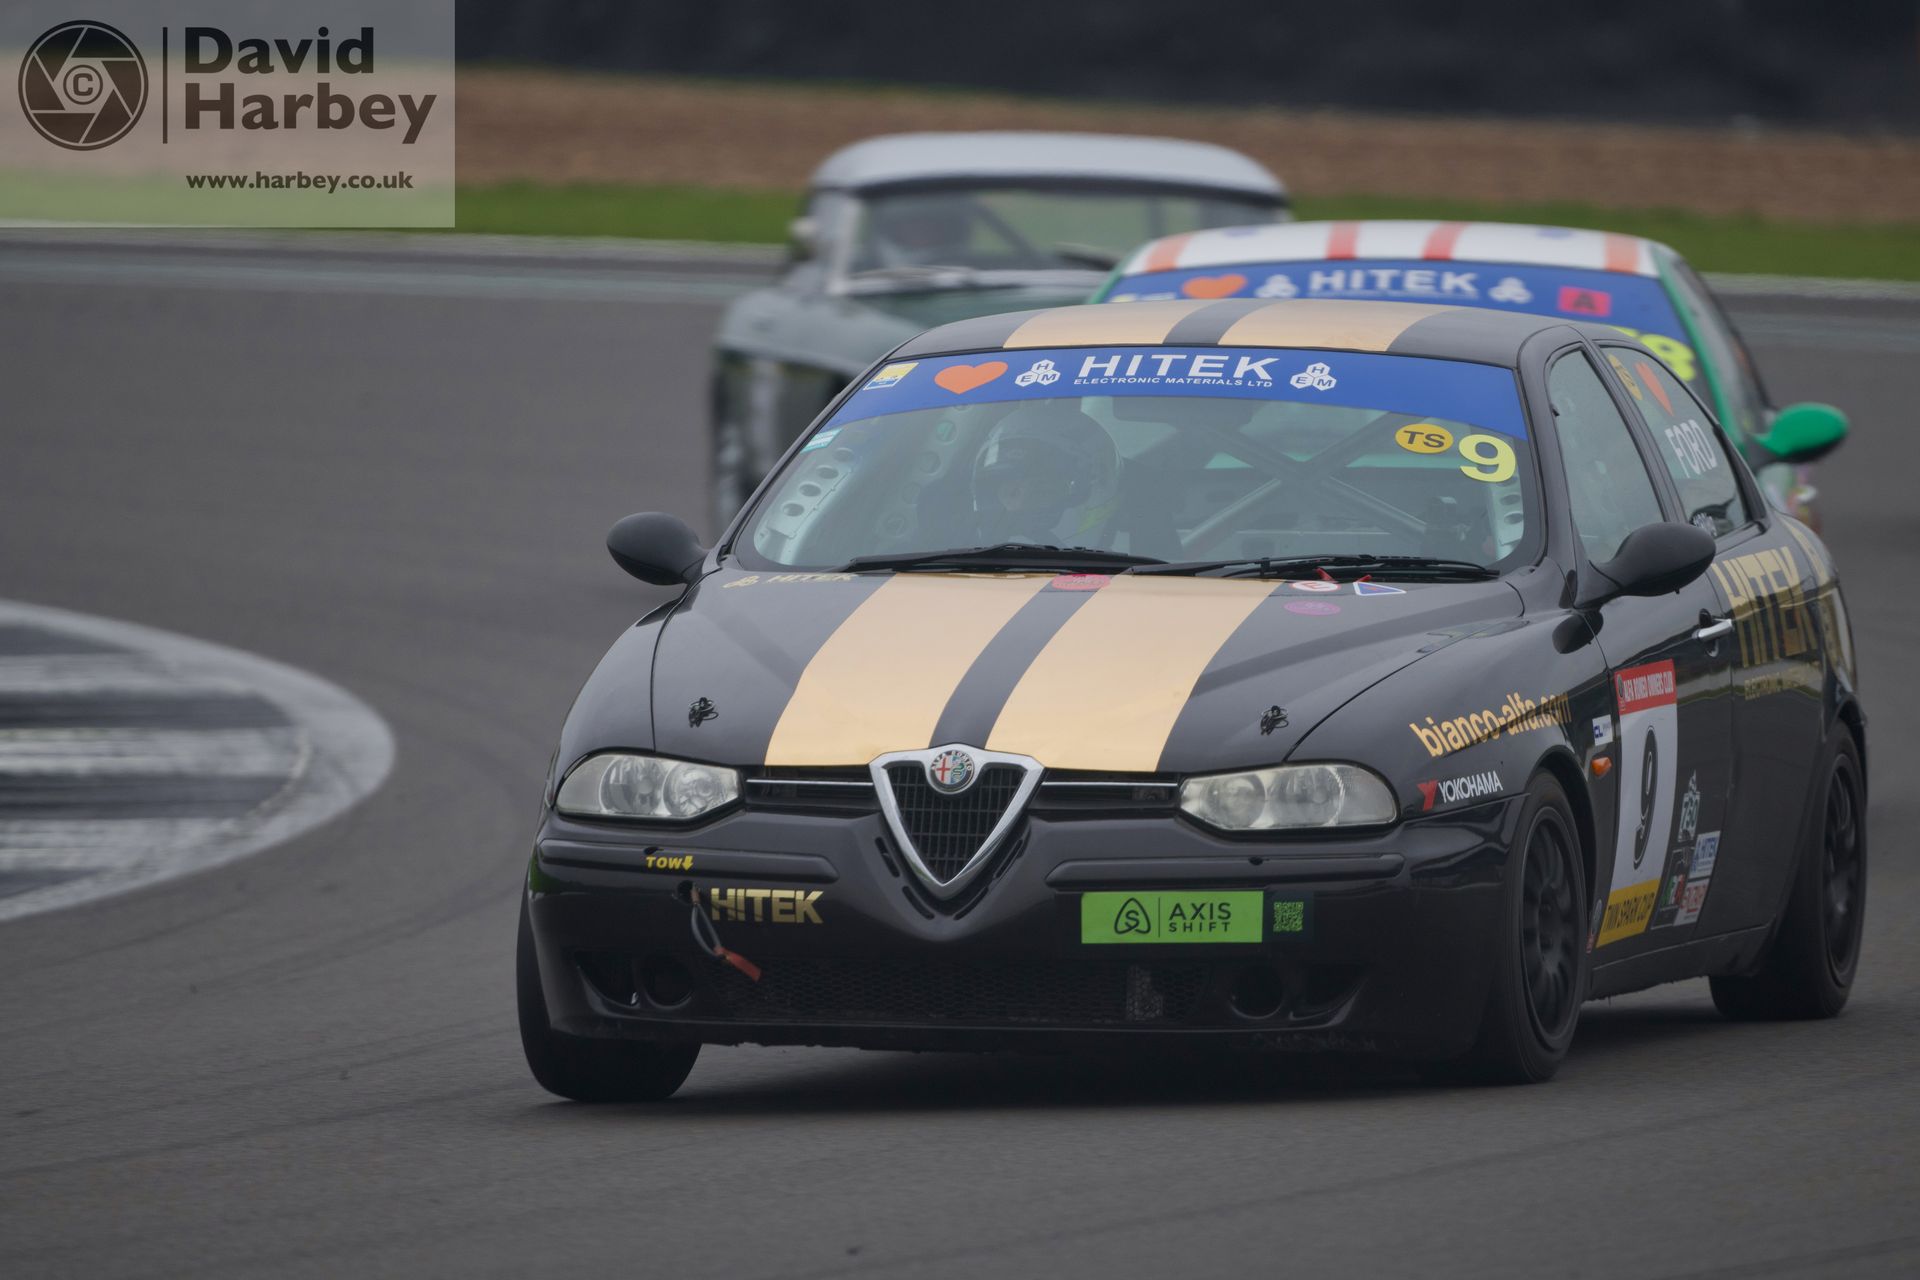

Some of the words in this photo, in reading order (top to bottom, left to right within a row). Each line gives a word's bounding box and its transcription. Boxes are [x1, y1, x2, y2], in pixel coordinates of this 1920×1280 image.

[1308, 269, 1479, 293] HITEK
[1077, 354, 1280, 380] HITEK
[1074, 377, 1160, 386] ELECTRONIC
[1165, 377, 1242, 386] MATERIALS
[1247, 380, 1273, 388] LTD
[1403, 430, 1446, 448] TS
[1664, 419, 1717, 478] FORD
[1458, 434, 1516, 482] 9
[1710, 546, 1818, 668] HITEK
[1409, 692, 1572, 757] bianco-alfa.com
[1438, 770, 1504, 803] YOKOHAMA
[1633, 725, 1658, 870] 9
[645, 856, 682, 869] TOW
[711, 888, 824, 924] HITEK
[1168, 902, 1232, 921] AXIS
[1168, 922, 1231, 932] SHIFT
